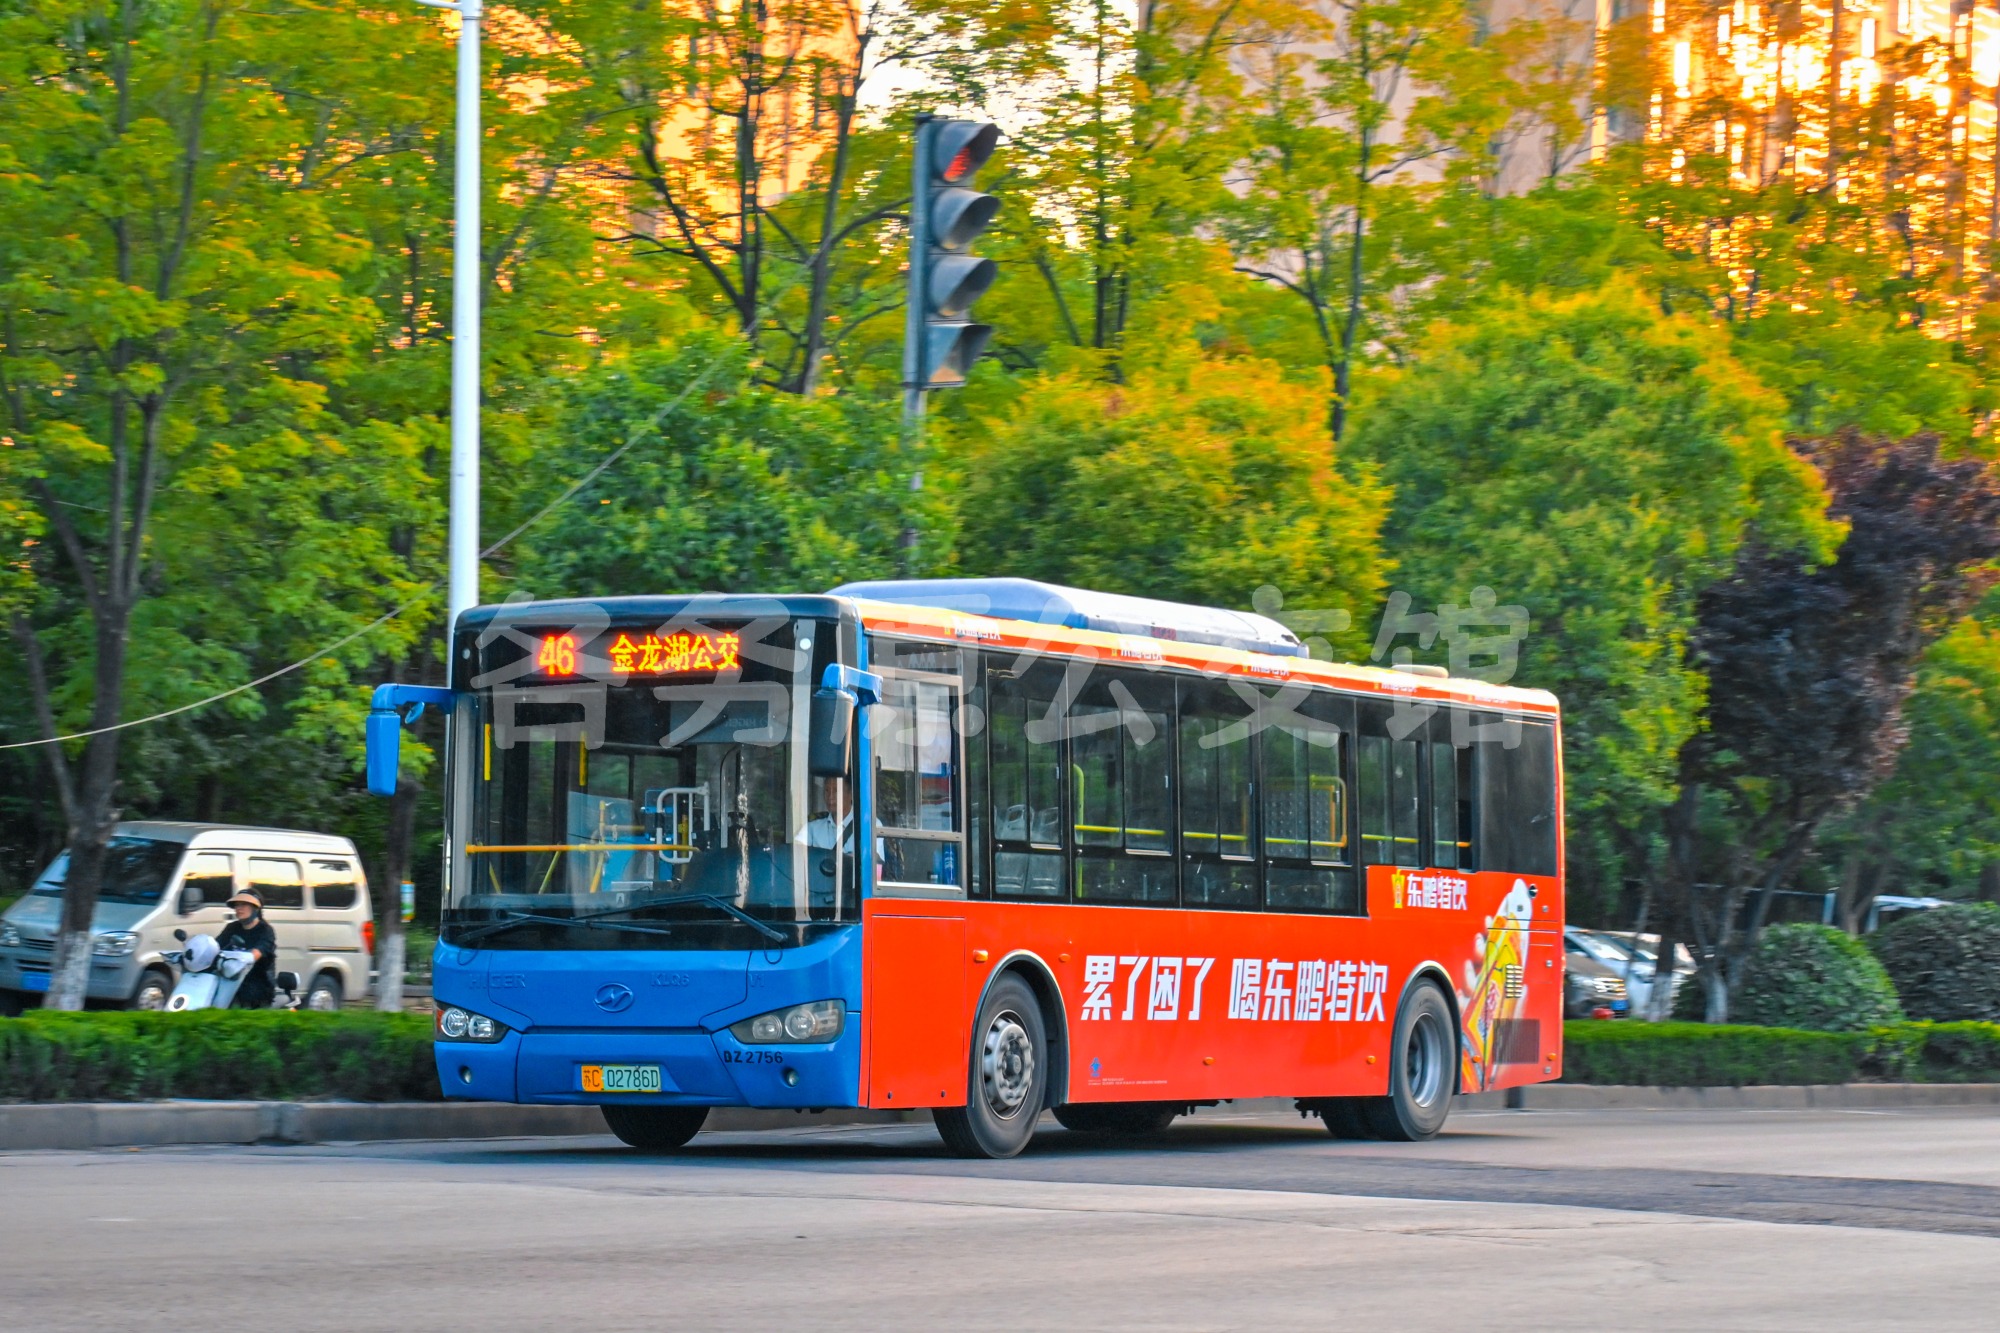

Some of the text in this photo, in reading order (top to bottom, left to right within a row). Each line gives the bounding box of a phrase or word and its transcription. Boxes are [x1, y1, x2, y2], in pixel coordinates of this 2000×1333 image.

[538, 632, 740, 676] 46 金龙湖公交
[1406, 873, 1468, 911] 东鹏特饮
[1080, 955, 1388, 1021] 累了困了 喝东鹏特饮
